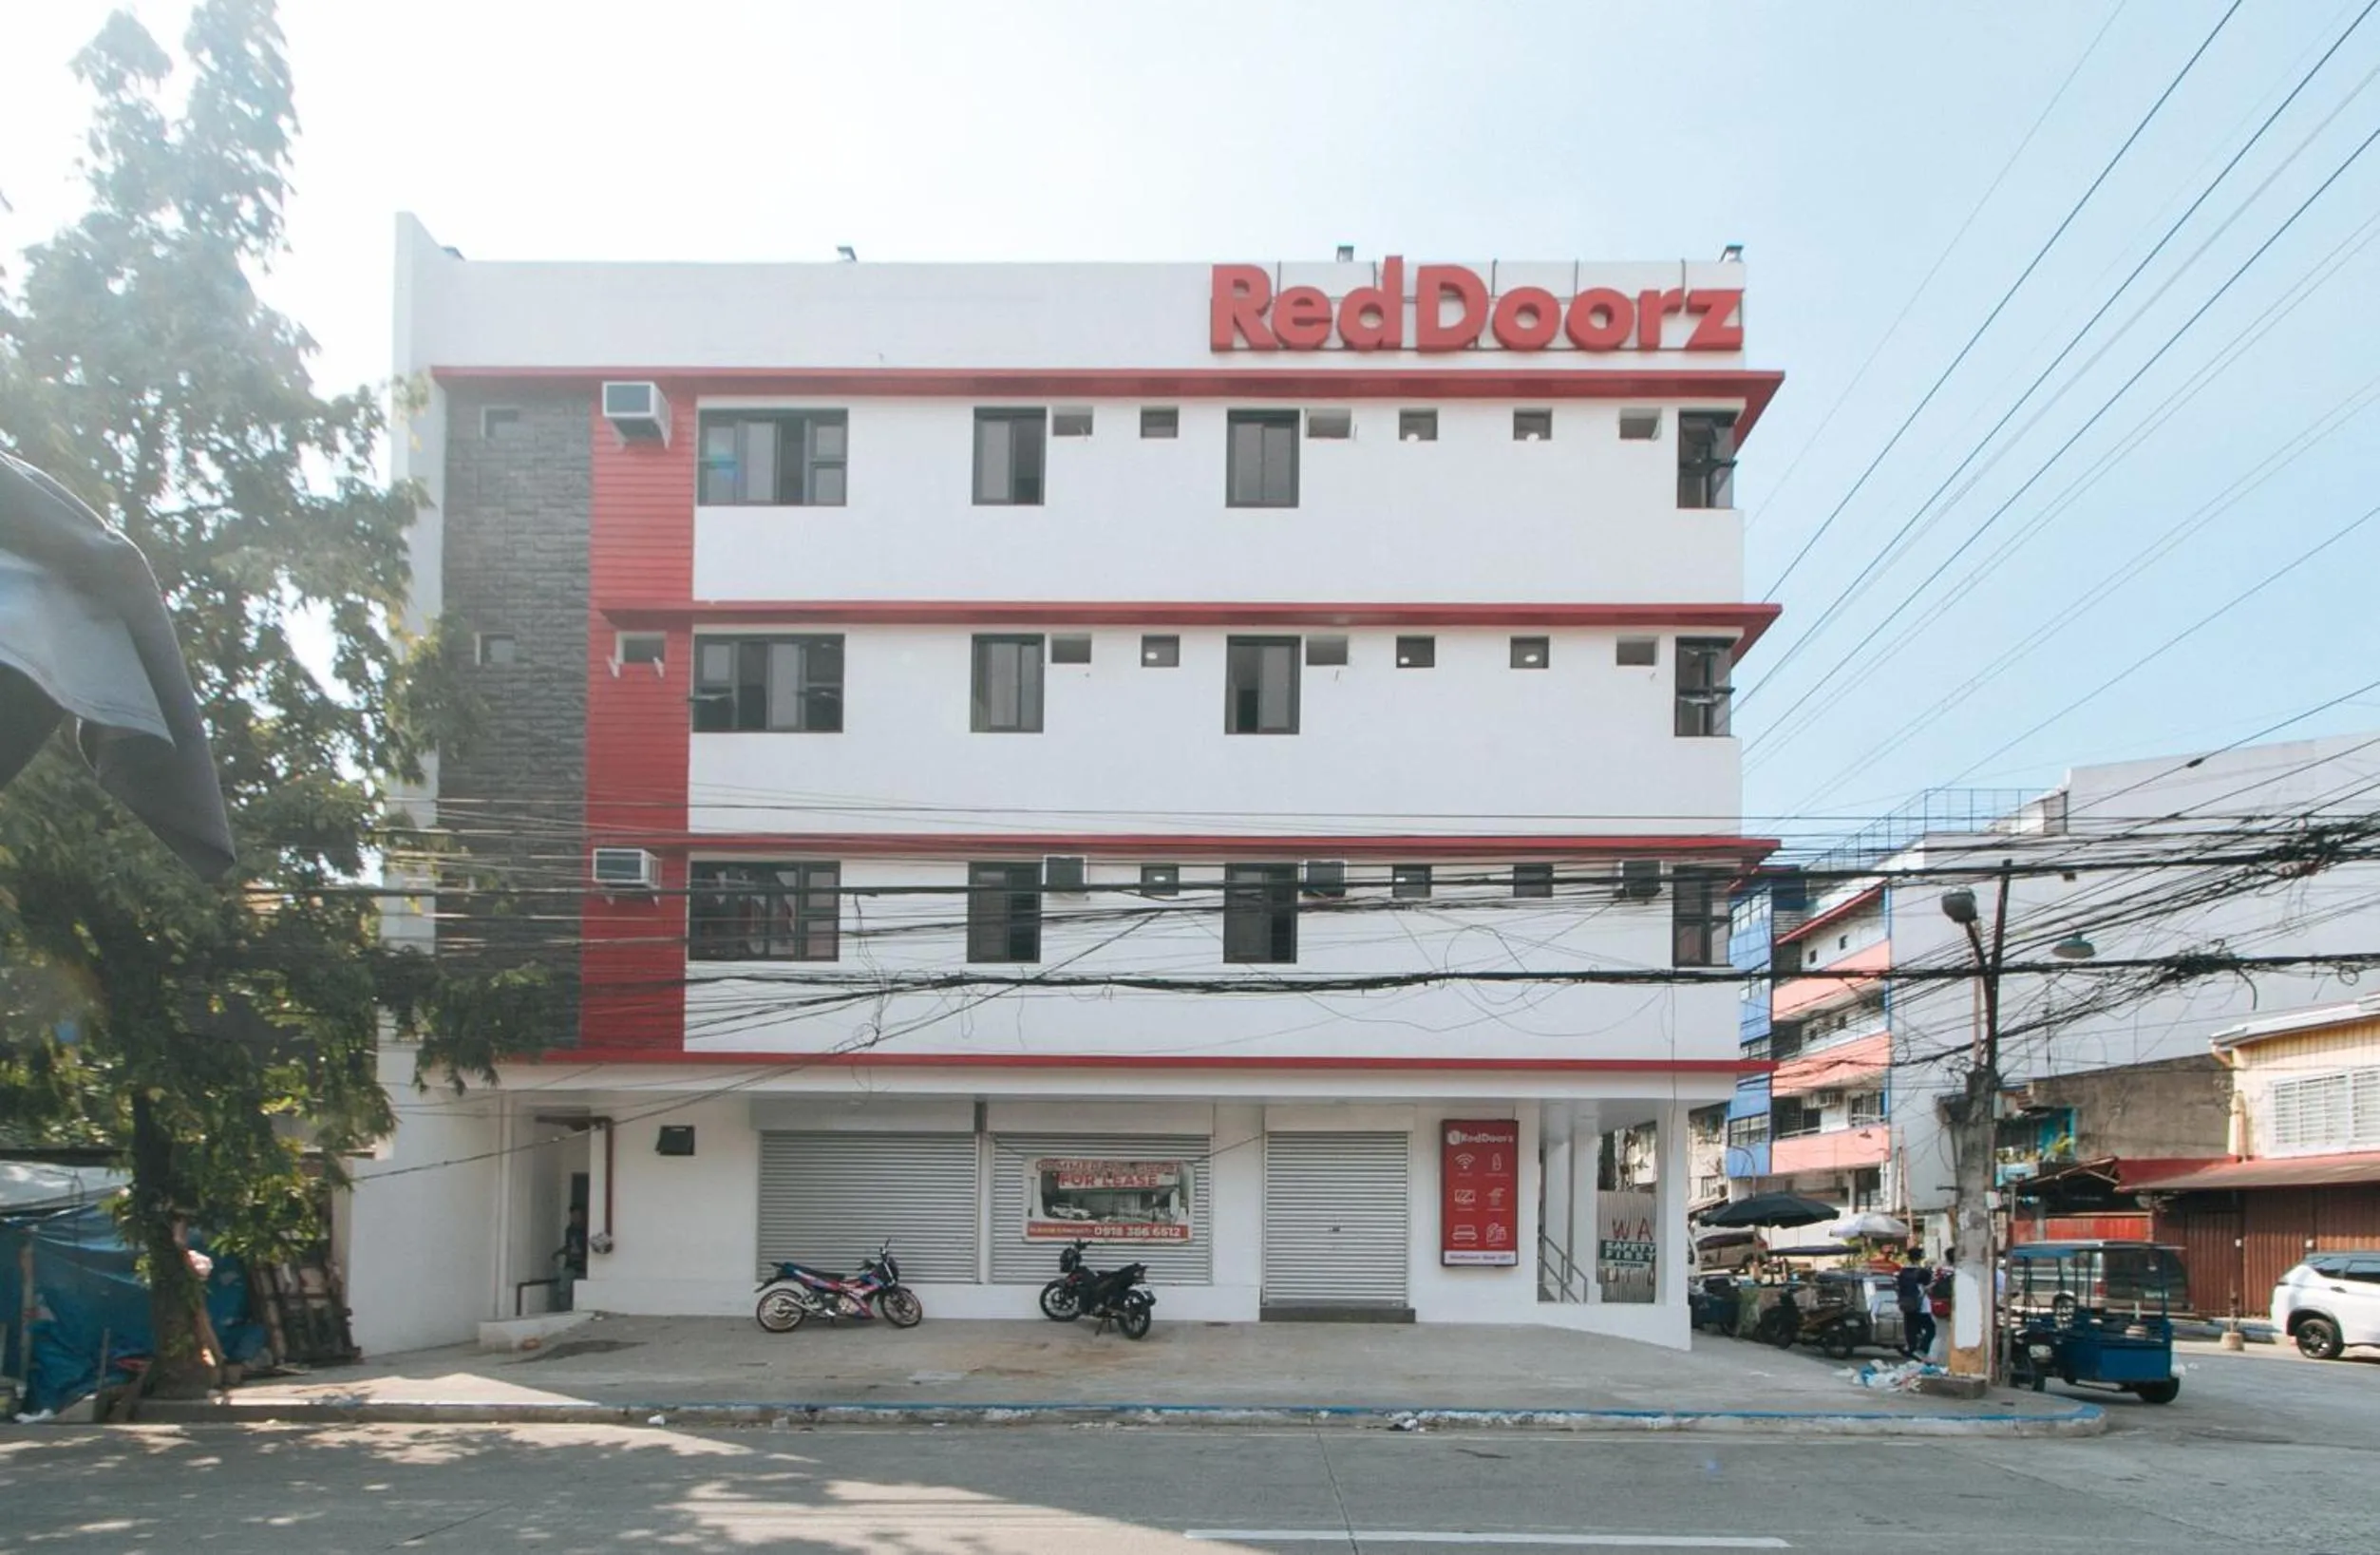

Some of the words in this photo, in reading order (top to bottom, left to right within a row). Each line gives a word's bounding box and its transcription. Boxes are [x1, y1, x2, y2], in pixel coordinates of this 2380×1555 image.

[1210, 255, 1744, 351] RedDoorz
[1461, 1132, 1515, 1144] RedDoorz
[1060, 1173, 1093, 1186] FOR
[1103, 1174, 1159, 1186] LEASE
[1605, 1241, 1656, 1253] SAFETY
[1605, 1250, 1656, 1261] FIRST
